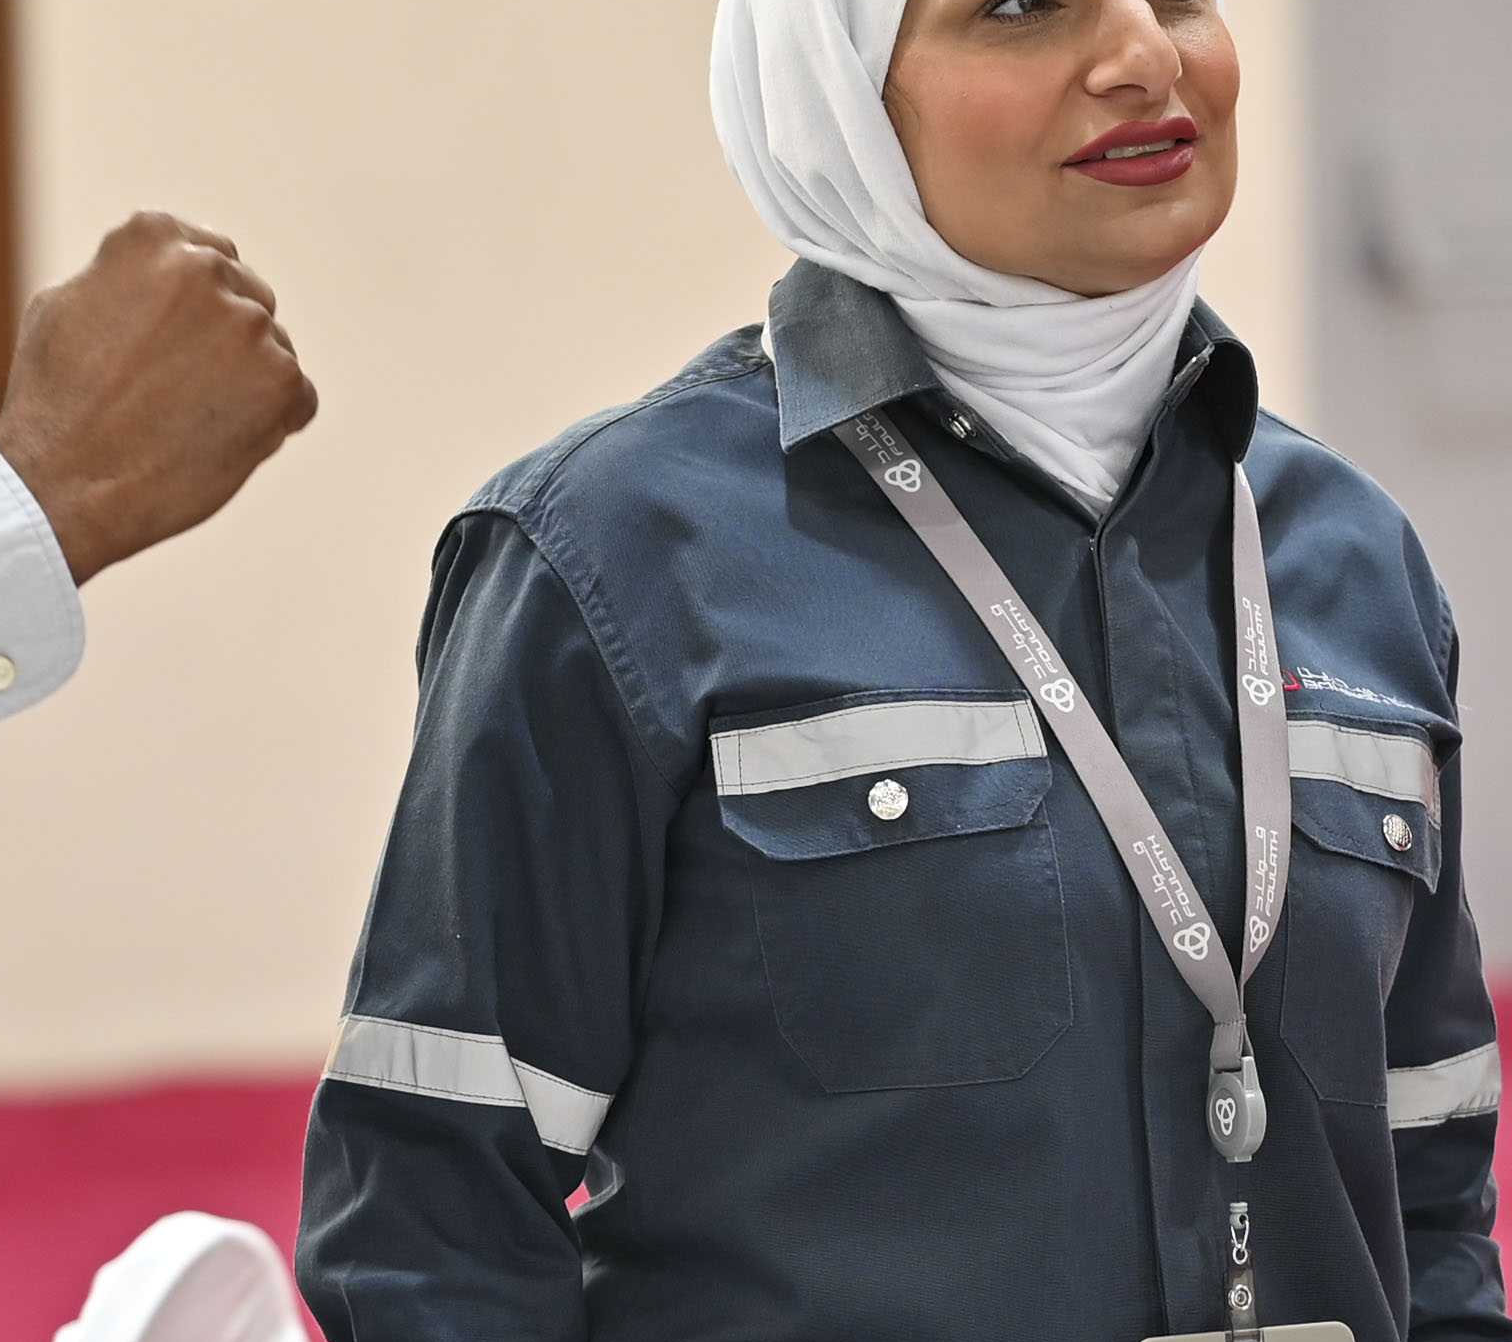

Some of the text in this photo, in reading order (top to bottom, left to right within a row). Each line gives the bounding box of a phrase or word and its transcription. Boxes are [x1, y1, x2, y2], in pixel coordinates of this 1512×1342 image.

[1003, 599, 1059, 674] FOULATH
[1253, 604, 1269, 676] FOULATH
[1146, 834, 1197, 919] FOULATH
[1264, 830, 1279, 917] FOULATH
